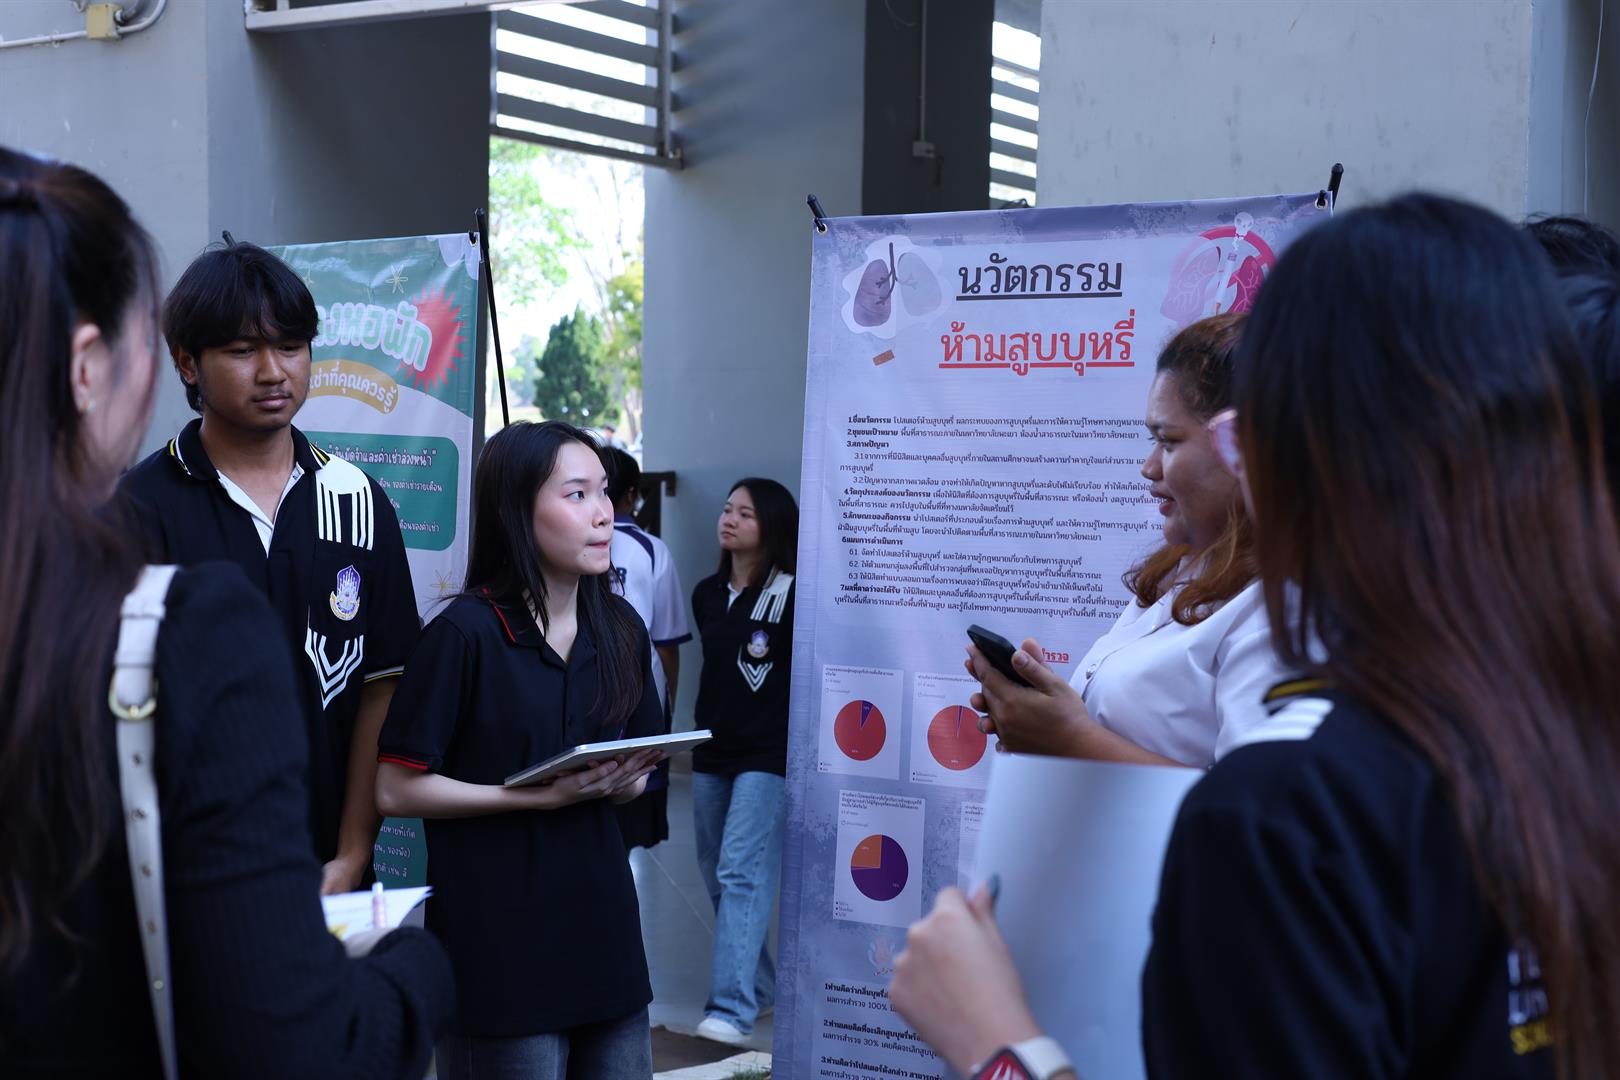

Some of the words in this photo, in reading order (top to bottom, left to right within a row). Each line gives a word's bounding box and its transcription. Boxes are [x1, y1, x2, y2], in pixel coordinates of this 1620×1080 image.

[957, 252, 1123, 298] นวัตกรรม
[939, 309, 1136, 376] ห้ามสูบบุหรี่
[868, 1001, 888, 1011] 100%
[863, 1038, 880, 1047] 30%
